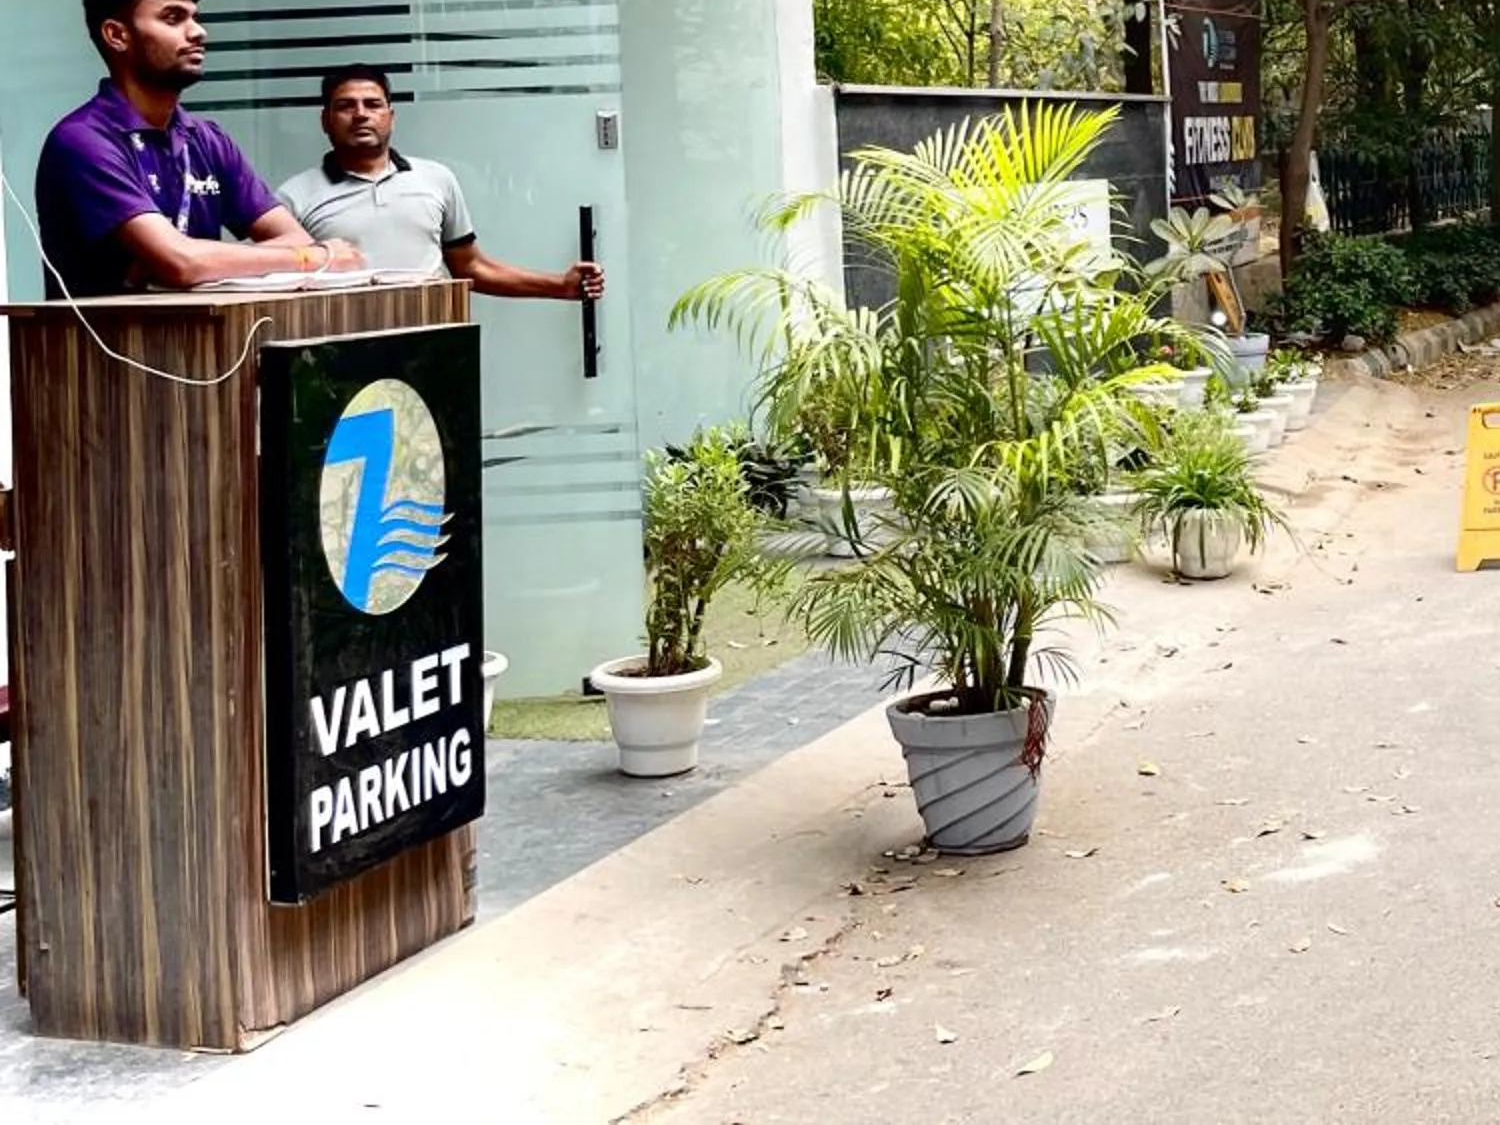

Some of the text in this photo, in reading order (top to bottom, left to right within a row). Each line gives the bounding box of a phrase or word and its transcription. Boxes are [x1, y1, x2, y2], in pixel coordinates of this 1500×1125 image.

[1184, 116, 1231, 165] FITNESS
[309, 641, 471, 757] VALET
[309, 728, 473, 853] PARKING
